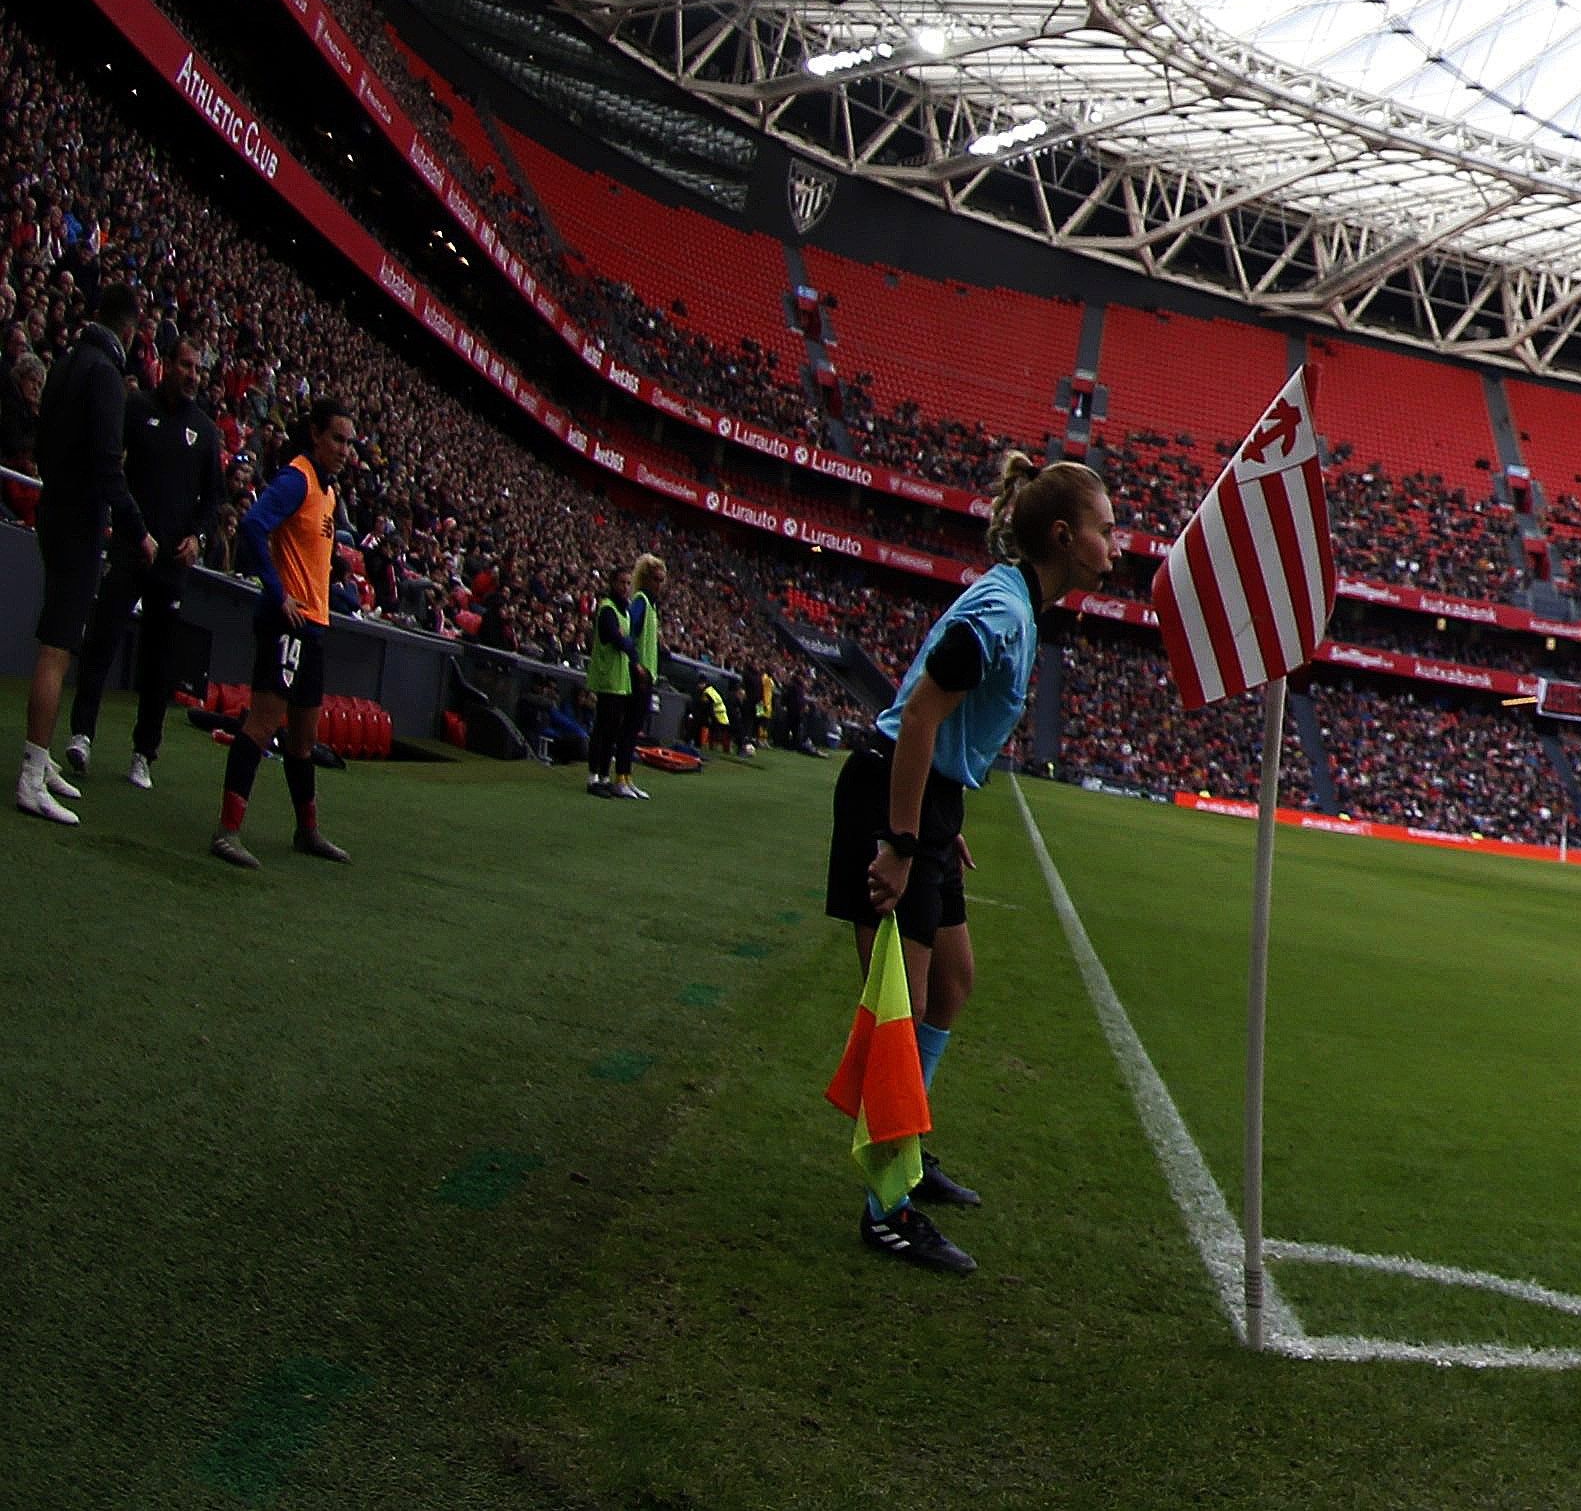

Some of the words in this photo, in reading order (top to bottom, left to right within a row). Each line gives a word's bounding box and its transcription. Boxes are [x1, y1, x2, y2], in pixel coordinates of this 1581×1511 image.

[175, 51, 244, 144] ATHLETIC
[245, 119, 280, 180] CLUB
[734, 421, 789, 459] Lurauto
[812, 450, 873, 487] Lurauto
[723, 495, 777, 531] Lurauto
[801, 521, 862, 557] Lurauto
[278, 634, 302, 670] 14
